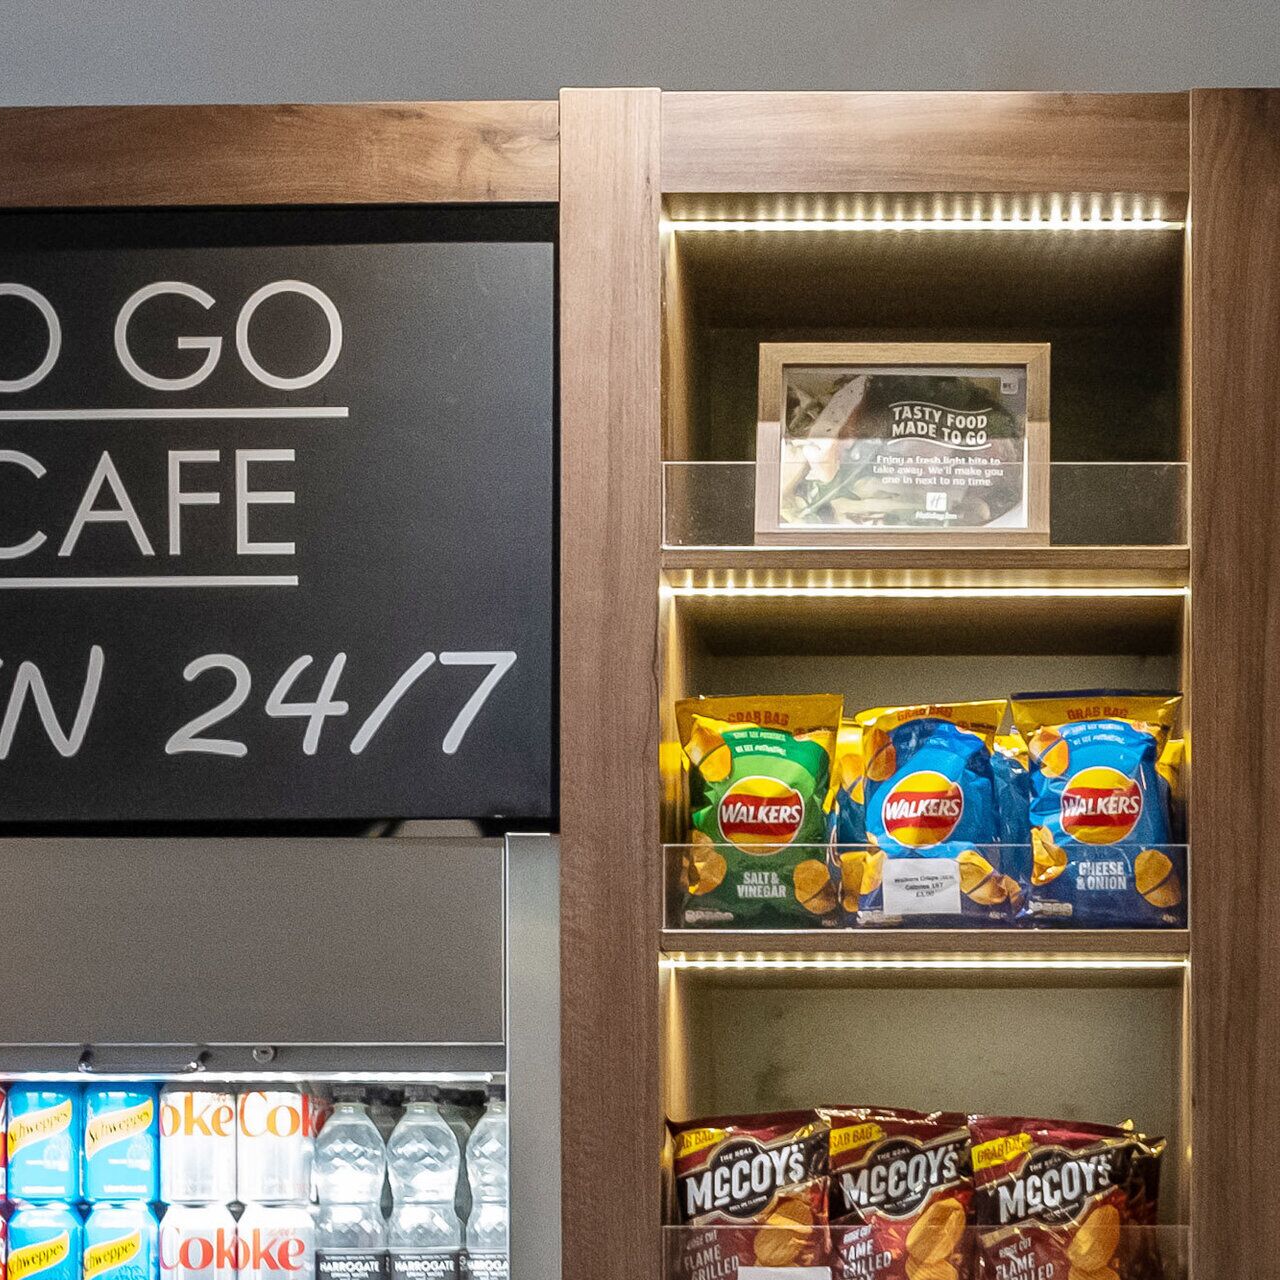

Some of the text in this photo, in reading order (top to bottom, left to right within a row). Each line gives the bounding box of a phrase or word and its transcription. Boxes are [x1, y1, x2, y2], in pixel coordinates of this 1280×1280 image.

[113, 279, 344, 391] GO
[892, 405, 988, 429] TASTY FOOD
[891, 423, 988, 445] MADE TO GO
[164, 650, 518, 757] 24/7
[721, 801, 802, 824] WALKERS
[884, 797, 963, 821] WALKERS
[1062, 795, 1140, 818] WALKERS
[742, 871, 770, 886] SALT
[1078, 861, 1125, 876] CHEESE
[736, 884, 787, 899] VINEGAR
[1086, 875, 1128, 890] ONION
[160, 1090, 234, 1138] oke
[319, 1261, 381, 1273] HARROGATE
[394, 1260, 456, 1272] HARROGATE
[684, 1243, 722, 1271] FLAME
[995, 1251, 1036, 1280] FLAME
